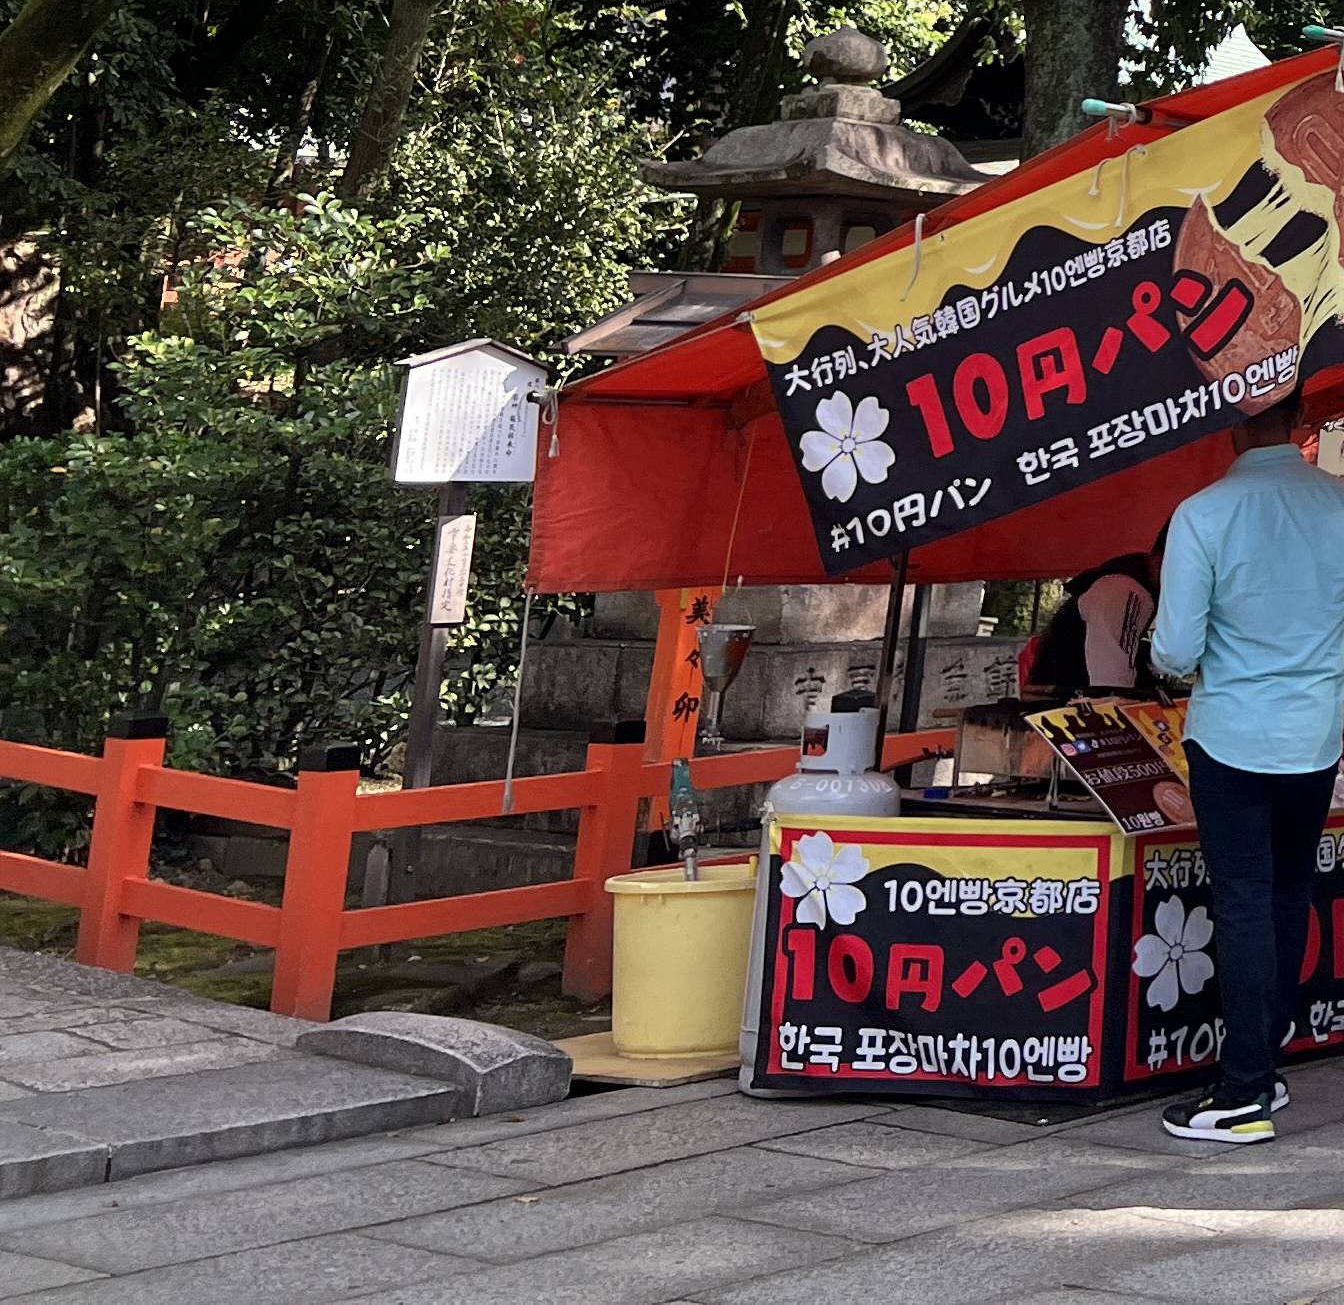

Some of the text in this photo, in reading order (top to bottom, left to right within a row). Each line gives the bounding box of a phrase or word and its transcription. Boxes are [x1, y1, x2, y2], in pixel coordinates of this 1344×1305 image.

[906, 275, 1250, 459] 10円パン
[1016, 345, 1299, 486] 한국 포장마차10엔빵
[830, 476, 992, 553] #10円パン
[884, 878, 1101, 917] 10엔빵京都店
[788, 928, 1092, 1013] 10円パン
[779, 1022, 1092, 1083] 한국 포장마차10엔빵
